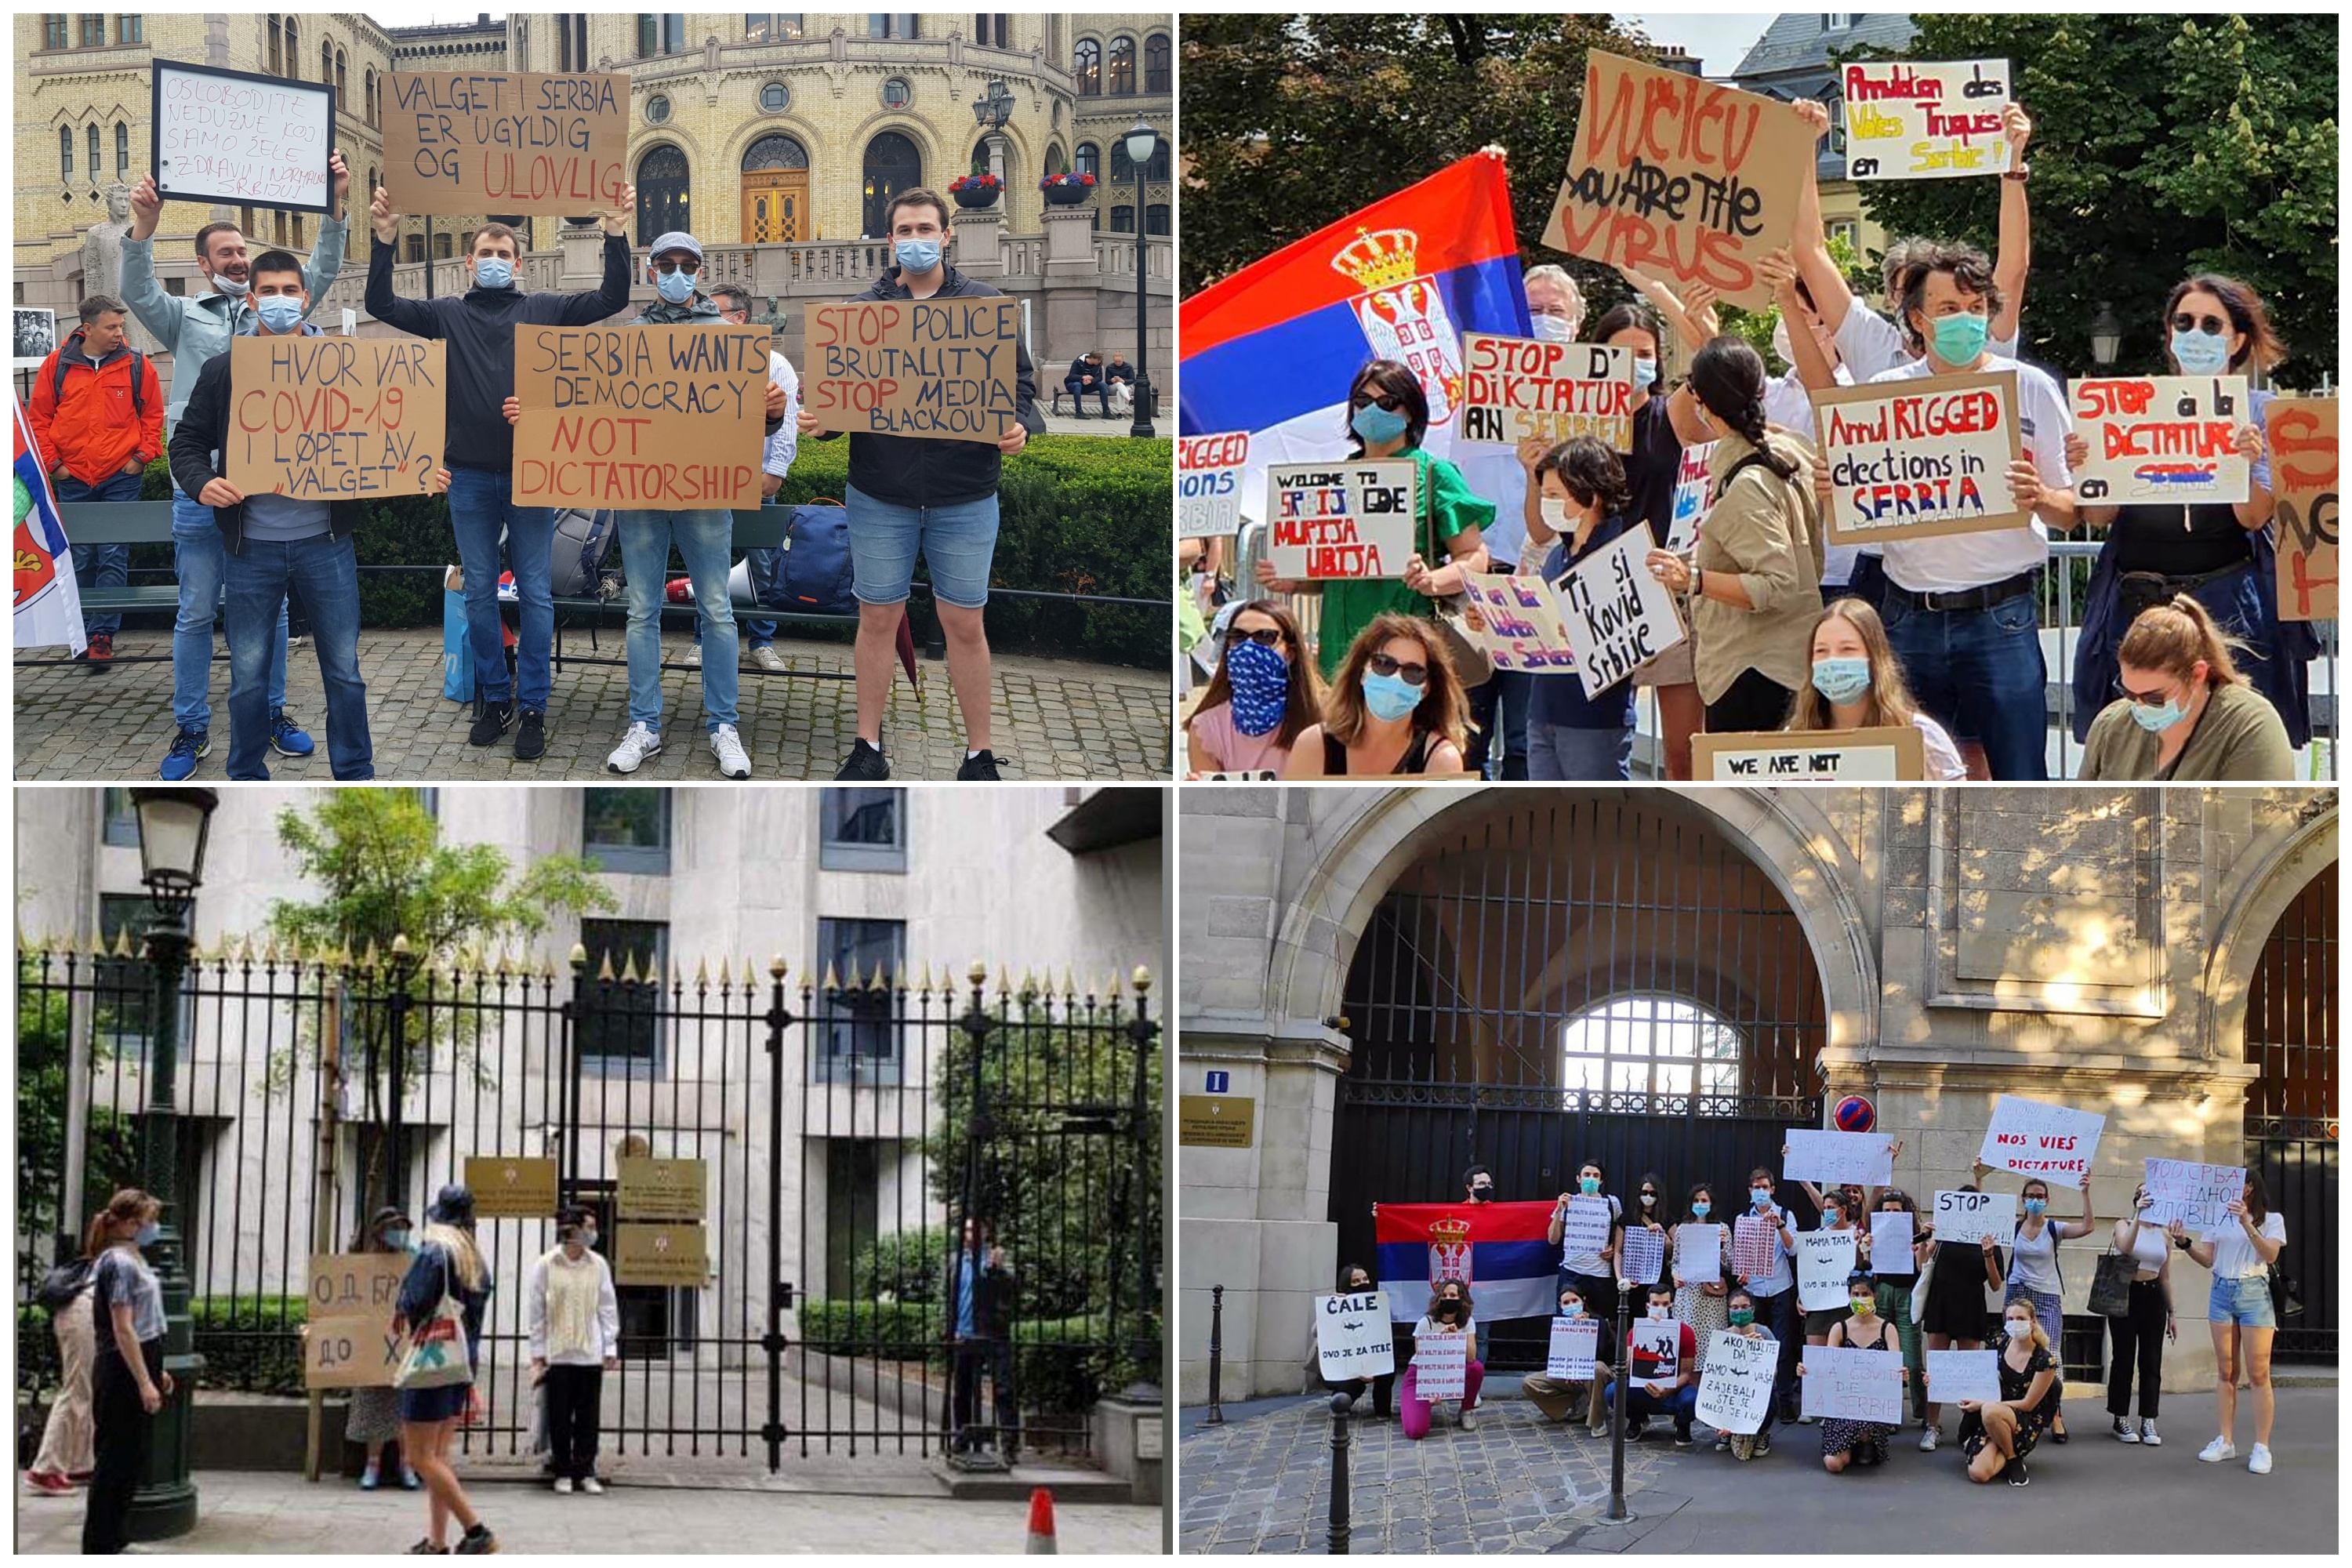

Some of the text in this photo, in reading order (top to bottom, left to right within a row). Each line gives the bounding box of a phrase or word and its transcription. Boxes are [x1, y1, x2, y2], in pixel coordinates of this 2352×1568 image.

[166, 78, 307, 118] OSLOBODITE
[392, 75, 618, 116] VALGET I SERBIA
[1963, 64, 2004, 99] des
[169, 103, 324, 147] NEDUŽNE KOJI
[416, 114, 590, 152] ER UGYLDIG
[165, 128, 305, 162] SAMO ŽELE
[174, 155, 252, 180] ZDRAVU
[415, 147, 622, 207] OG ULOVLIG
[1852, 158, 1878, 177] en
[1561, 205, 1754, 292] VIRUS
[815, 303, 1016, 347] STOP POLICE
[272, 342, 434, 387] HVOR VAR
[532, 330, 770, 378] SERBIA WANTS
[826, 345, 1000, 380] BRUTALITY
[1472, 339, 1564, 377] STOP
[238, 387, 404, 434] COVID-19
[555, 376, 749, 419] DEMOCRACY
[817, 379, 1015, 412] STOP MEDIA
[2077, 381, 2155, 419] STOP
[551, 416, 652, 456] NOT
[870, 407, 1015, 437] BLACKOUT
[1465, 406, 1504, 441] AN
[1829, 391, 1999, 448] Annul RIGGED
[247, 430, 416, 467] I LØPET AV
[521, 459, 753, 503] DICTATORSHIP
[1276, 471, 1377, 488] WELCOME TO
[1832, 448, 1985, 487] elections in
[1853, 476, 1985, 531] SERBIA
[1306, 544, 1382, 579] UBIJA
[1559, 547, 1631, 613] Ti si
[1584, 579, 1644, 645] Kovid
[1588, 622, 1656, 689] Srbije
[1728, 753, 1841, 775] WE ARE NOT
[1997, 1134, 2078, 1151] NOS VIES
[2008, 1158, 2085, 1172] DICTATURE
[1940, 1192, 1991, 1212] STOP
[1806, 1236, 1851, 1247] MAMA TATA
[1327, 1295, 1378, 1315] ČALE
[1323, 1343, 1392, 1359] OVO JE ZA TEBE
[1722, 1336, 1743, 1348] AKO
[1733, 1348, 1746, 1360] DA
[1704, 1363, 1727, 1377] SAMO
[1706, 1380, 1755, 1399] ZAJEBALI
[1715, 1394, 1749, 1408] STE SE
[1701, 1402, 1724, 1414] MALO
[1730, 1407, 1741, 1417] JE
